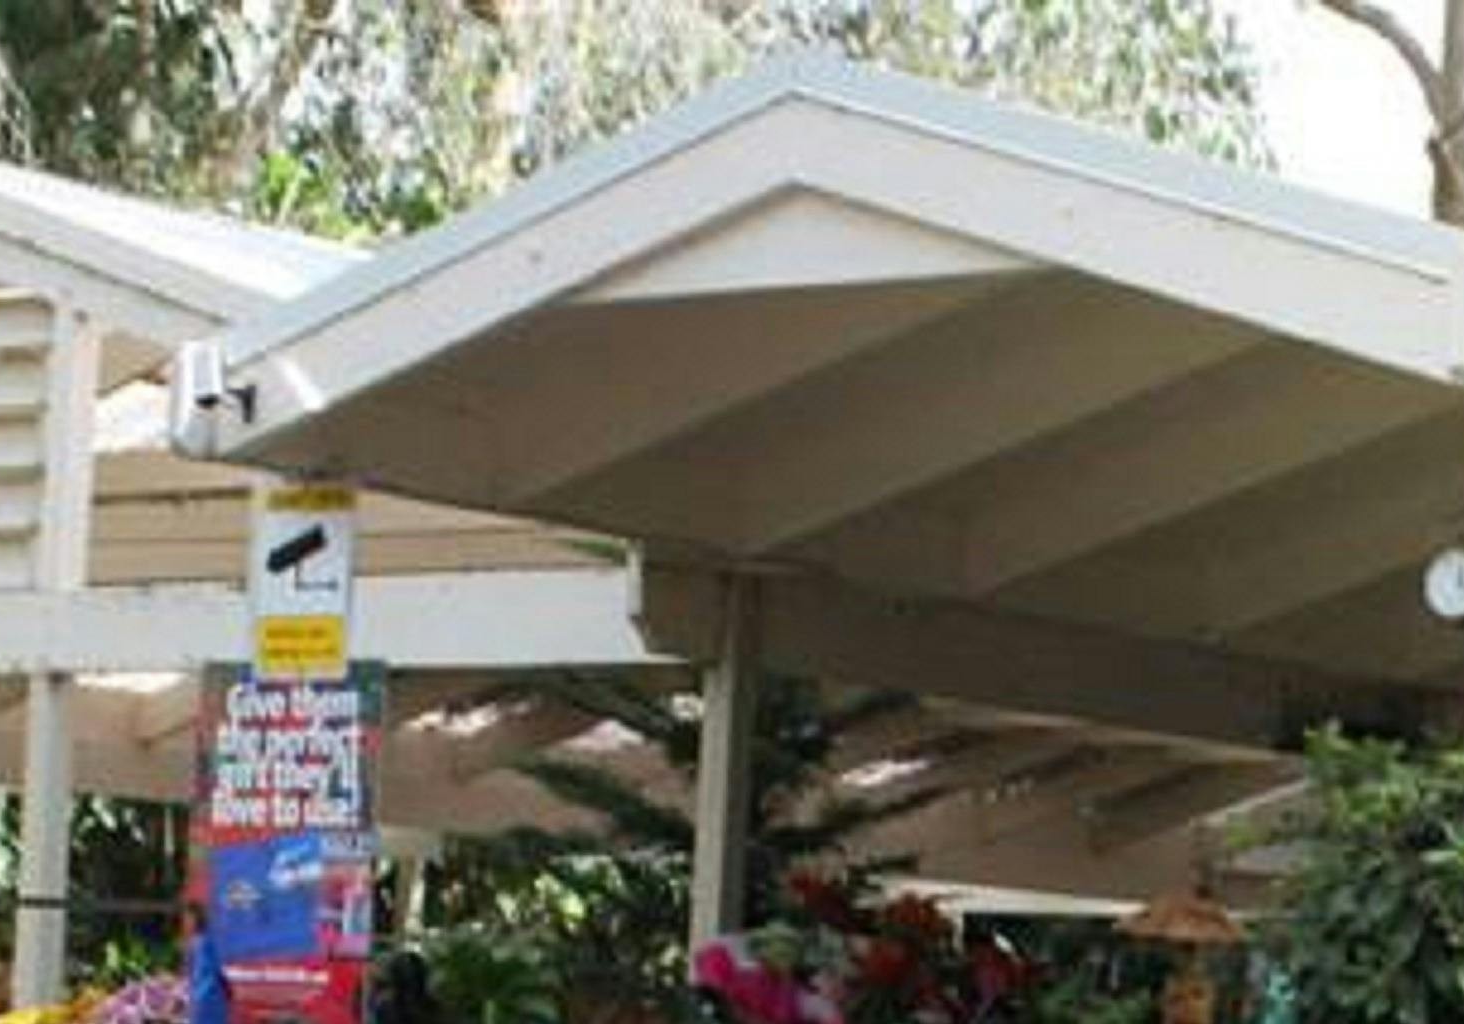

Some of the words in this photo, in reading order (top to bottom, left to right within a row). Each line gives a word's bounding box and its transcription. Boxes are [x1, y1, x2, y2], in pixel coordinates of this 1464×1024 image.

[226, 683, 286, 720] Give
[289, 682, 359, 720] them
[217, 722, 264, 756] the
[266, 720, 359, 761] perfect
[216, 757, 270, 796] gift
[273, 757, 360, 795] they'll
[211, 788, 270, 828] love
[273, 794, 301, 828] to
[303, 790, 361, 828] use!
